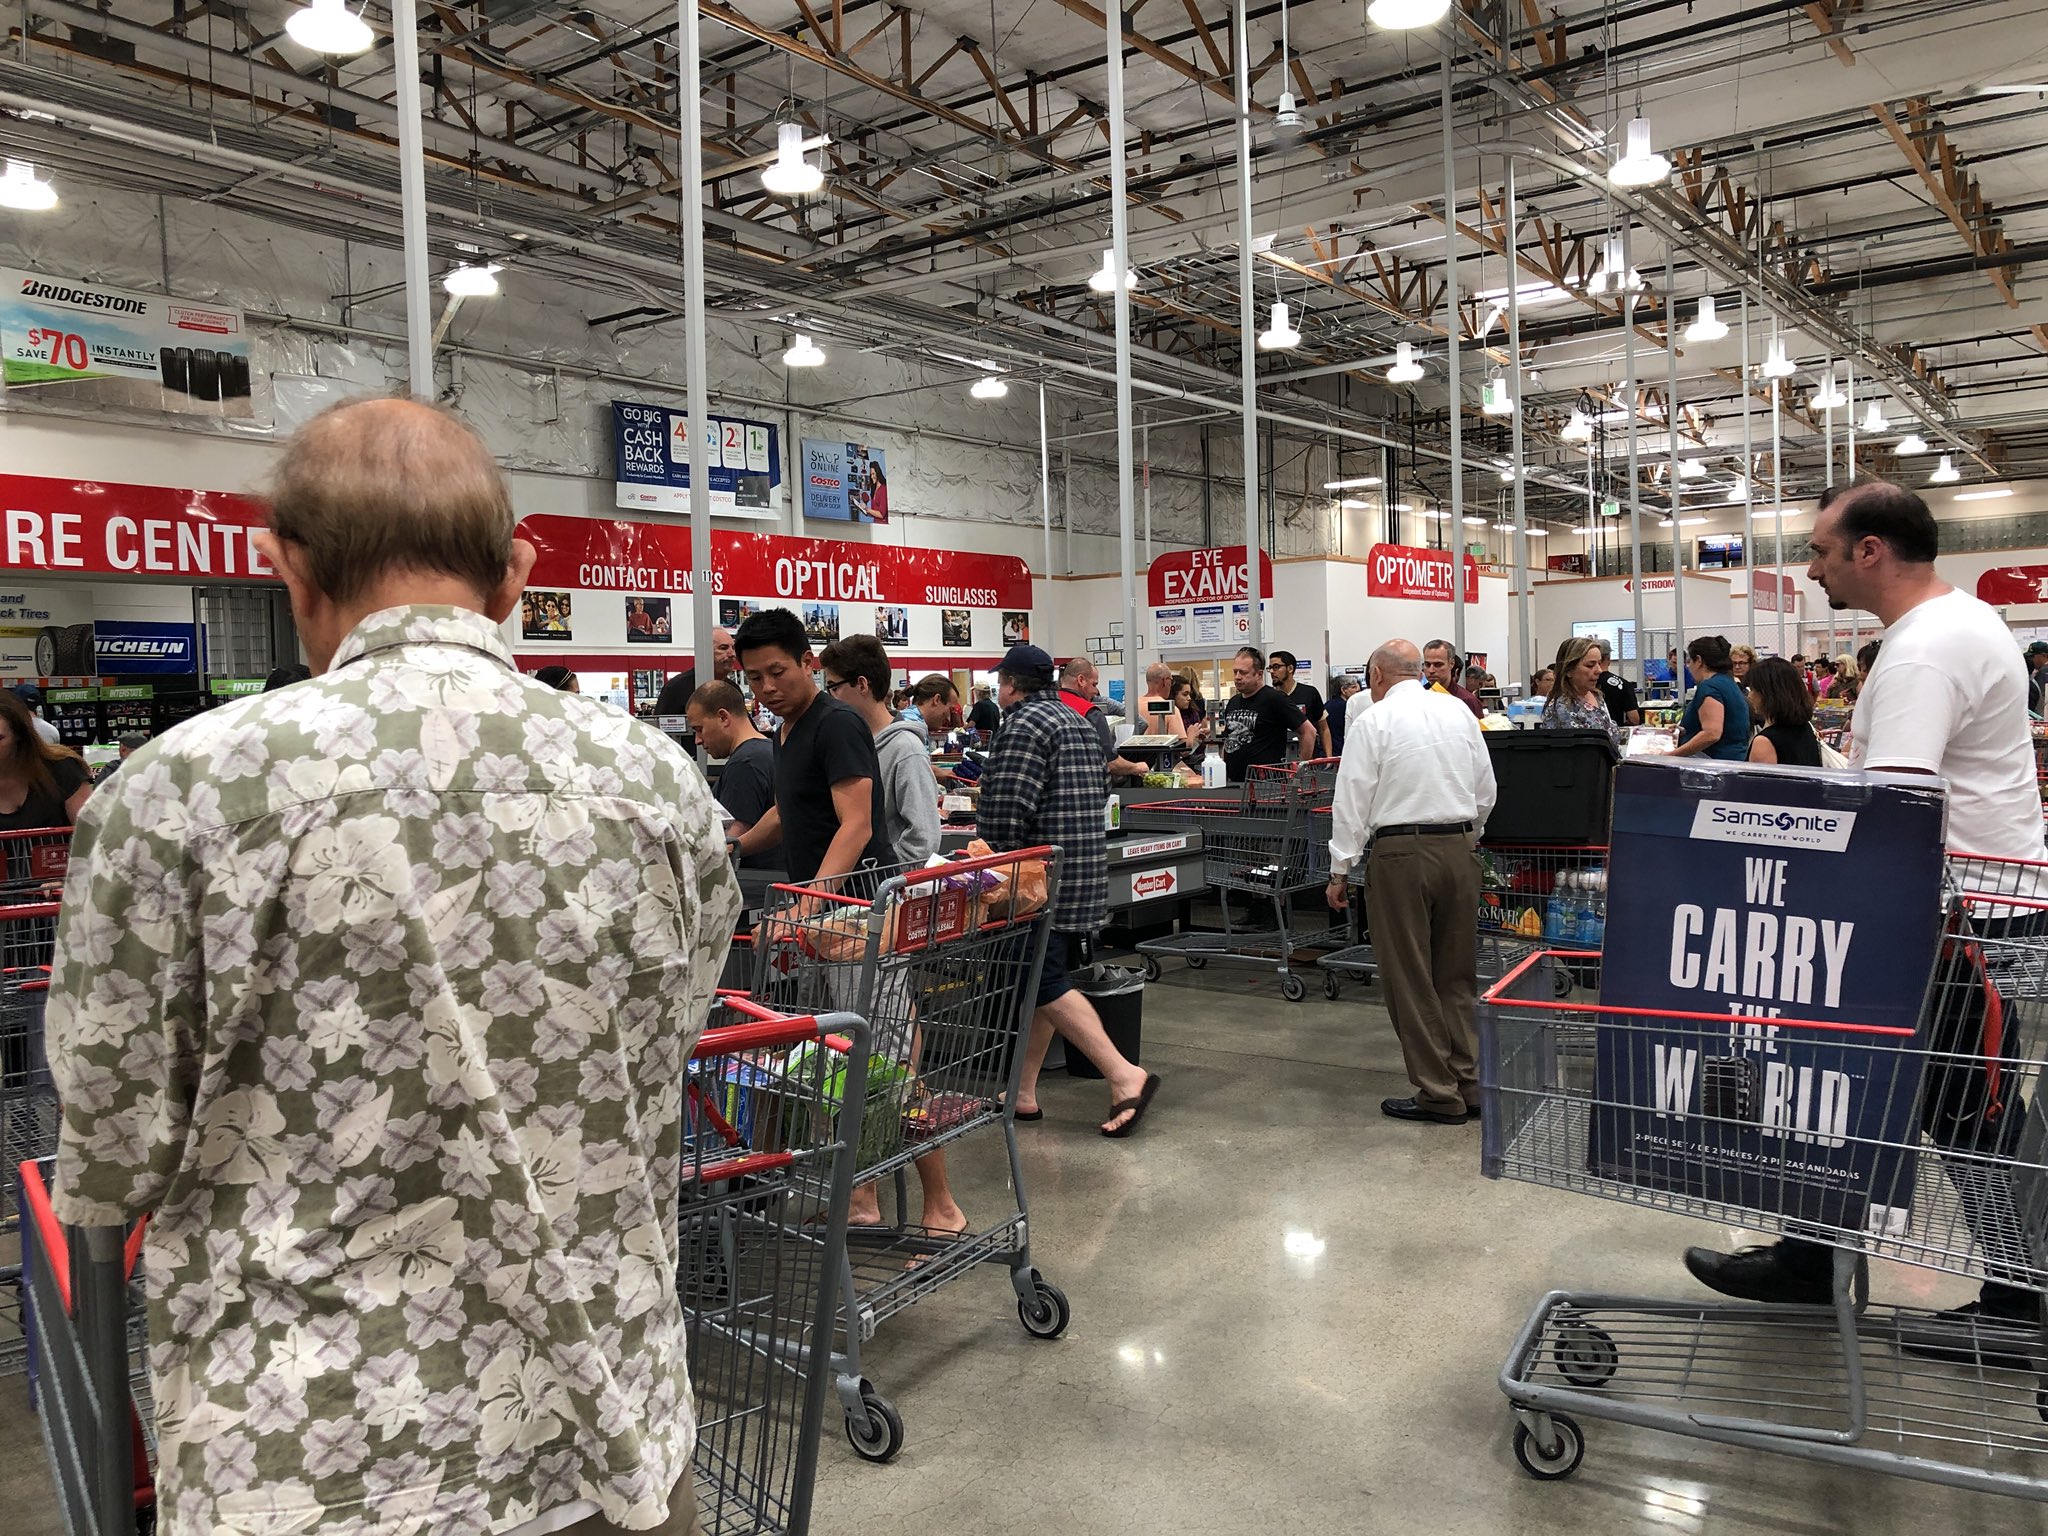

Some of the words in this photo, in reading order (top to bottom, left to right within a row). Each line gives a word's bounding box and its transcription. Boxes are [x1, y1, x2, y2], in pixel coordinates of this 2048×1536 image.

[20, 280, 147, 314] BRIDGESTONE
[17, 347, 48, 360] SAVE
[92, 344, 156, 362] INSTANTLY
[624, 408, 642, 421] GO
[644, 411, 662, 424] BIG
[624, 428, 663, 447] CASH
[625, 445, 664, 464] BACK
[811, 450, 840, 464] SHOP
[626, 462, 664, 474] REWARDS
[810, 462, 840, 473] ONLINE
[810, 476, 840, 486] COSTCO
[811, 494, 840, 503] DELIVERY
[105, 516, 274, 576] CENTE
[1192, 550, 1224, 568] EYE
[579, 564, 658, 589] CONTACT
[664, 569, 724, 592] LENS
[774, 558, 885, 602] OPTICAL
[1164, 564, 1248, 599] EXAMS
[1376, 555, 1472, 591] OPTOMETRT
[0, 594, 24, 603] and
[925, 585, 998, 606] SUNGLASSES
[20, 608, 50, 618] Tires
[56, 690, 88, 701] INTERSTATE
[110, 686, 144, 698] INTERSTATE
[1712, 807, 1838, 832] Samsonite
[1742, 831, 1768, 839] CARRY
[1792, 836, 1822, 844] WORLD
[1128, 846, 1140, 856] LEAVE
[1140, 845, 1153, 853] HEAVY
[1154, 842, 1166, 851] ITEMS
[1156, 878, 1166, 888] Cart
[1745, 857, 1788, 907] WE
[908, 928, 928, 940] COSTCO
[1670, 904, 1854, 1008] CARRY
[1729, 1002, 1781, 1054] THE
[1770, 1157, 1804, 1170] PIZAS
[1806, 1164, 1860, 1180] ANIDADAS
